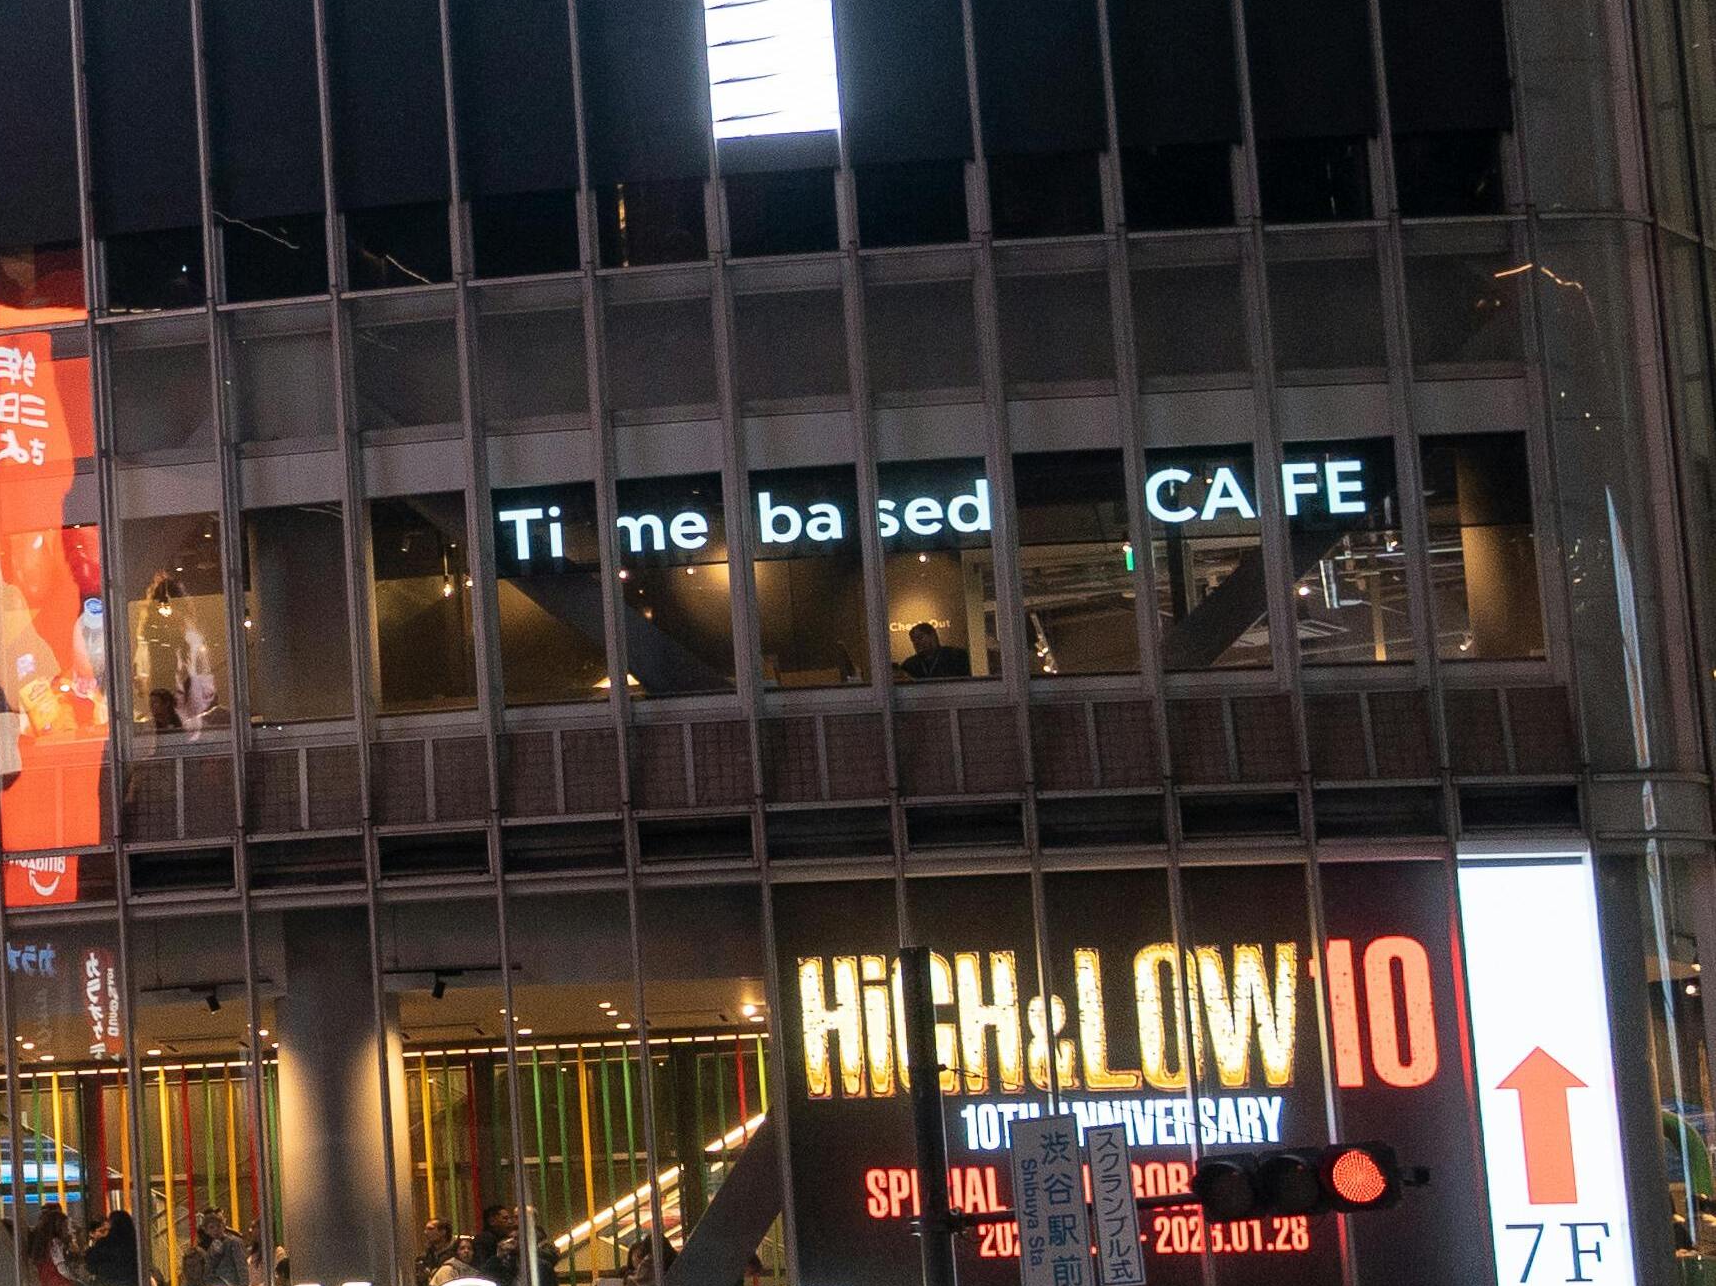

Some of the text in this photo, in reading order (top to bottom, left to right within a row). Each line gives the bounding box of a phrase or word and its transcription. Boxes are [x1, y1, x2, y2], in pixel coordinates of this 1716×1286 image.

[499, 460, 1366, 562] Time based CAFE
[1020, 1157, 1040, 1273] Shibuya Sta.
[1093, 1129, 1136, 1283] スクランブル式
[1505, 1223, 1609, 1285] 7F
